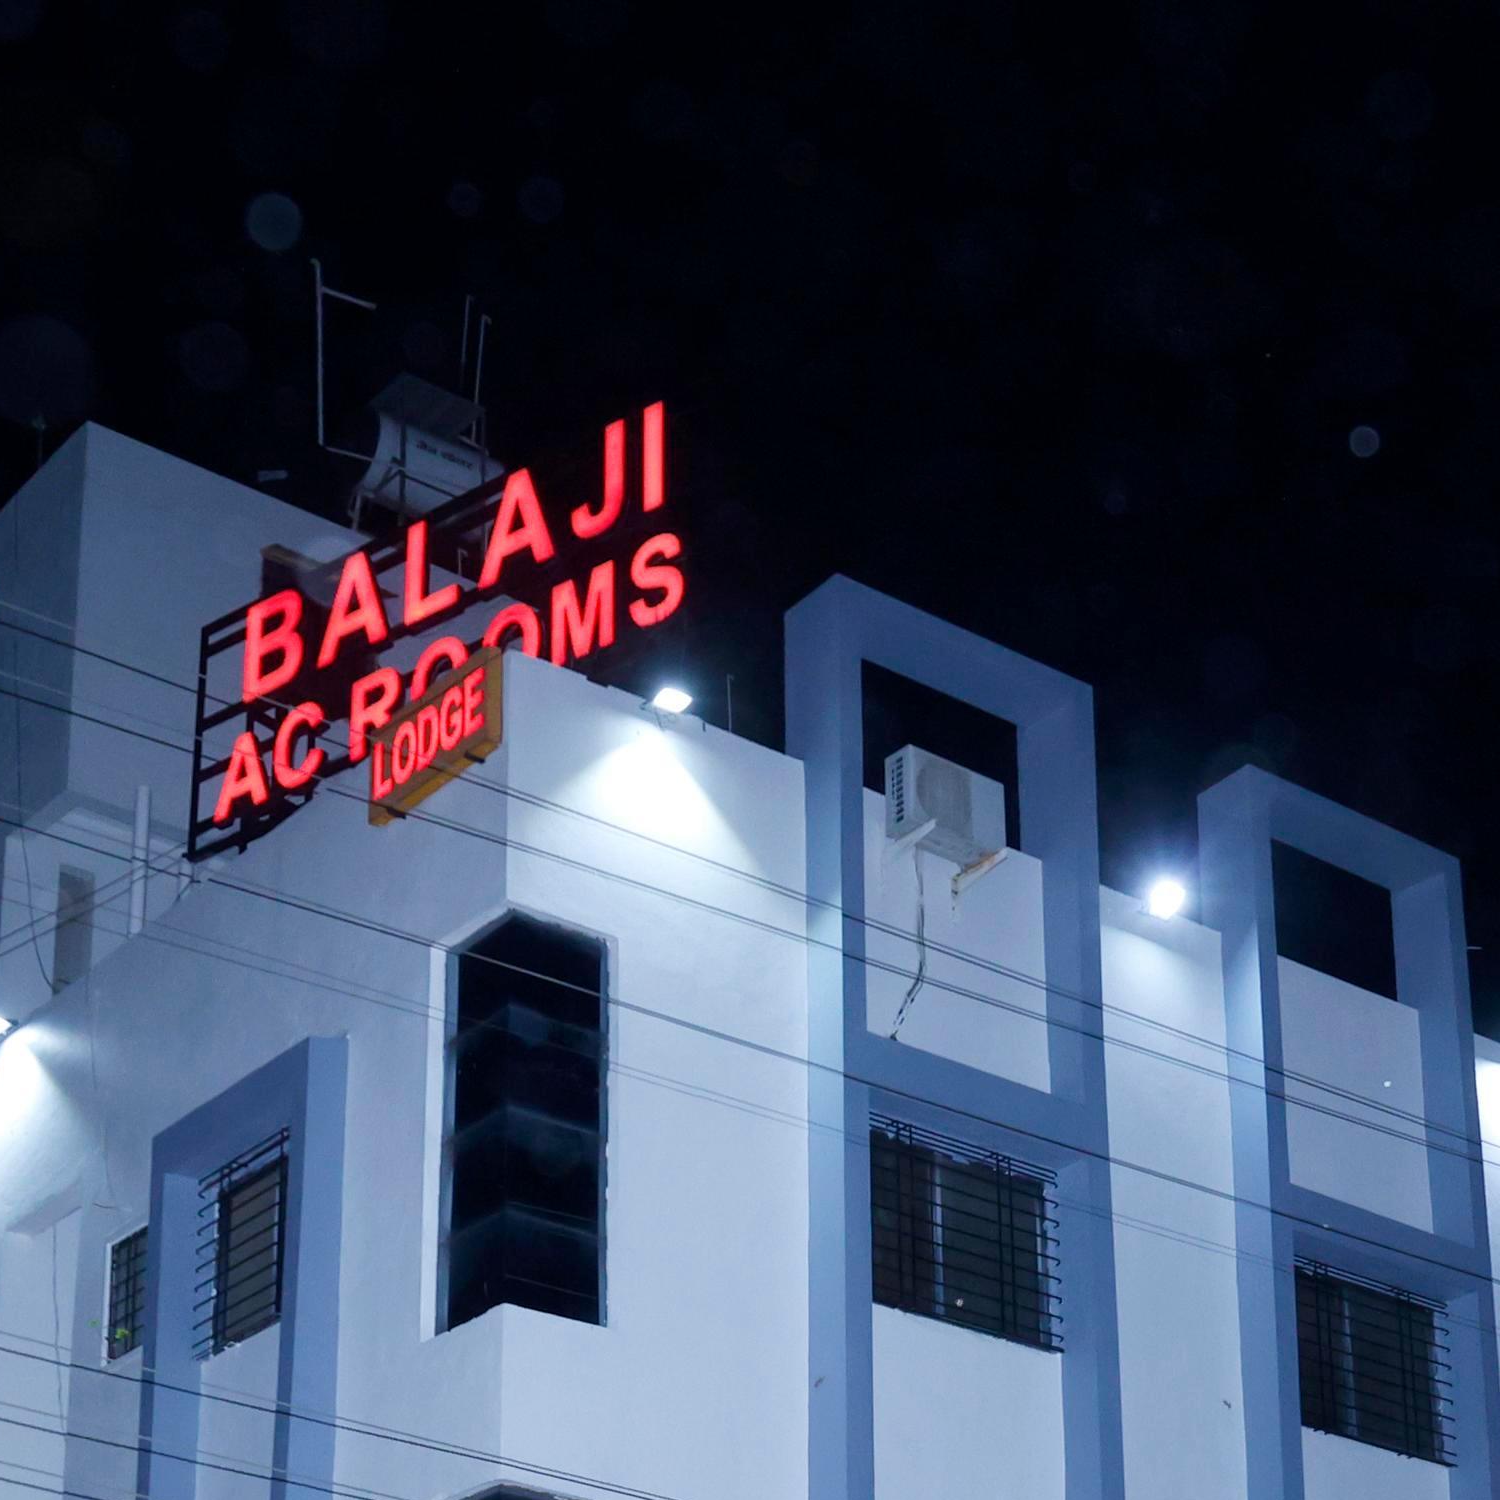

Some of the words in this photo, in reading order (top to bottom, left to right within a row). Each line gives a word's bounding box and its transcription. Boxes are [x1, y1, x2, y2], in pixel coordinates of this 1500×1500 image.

[243, 400, 665, 704] BALAJI
[212, 702, 325, 827] AC
[372, 666, 486, 801] LODGE
